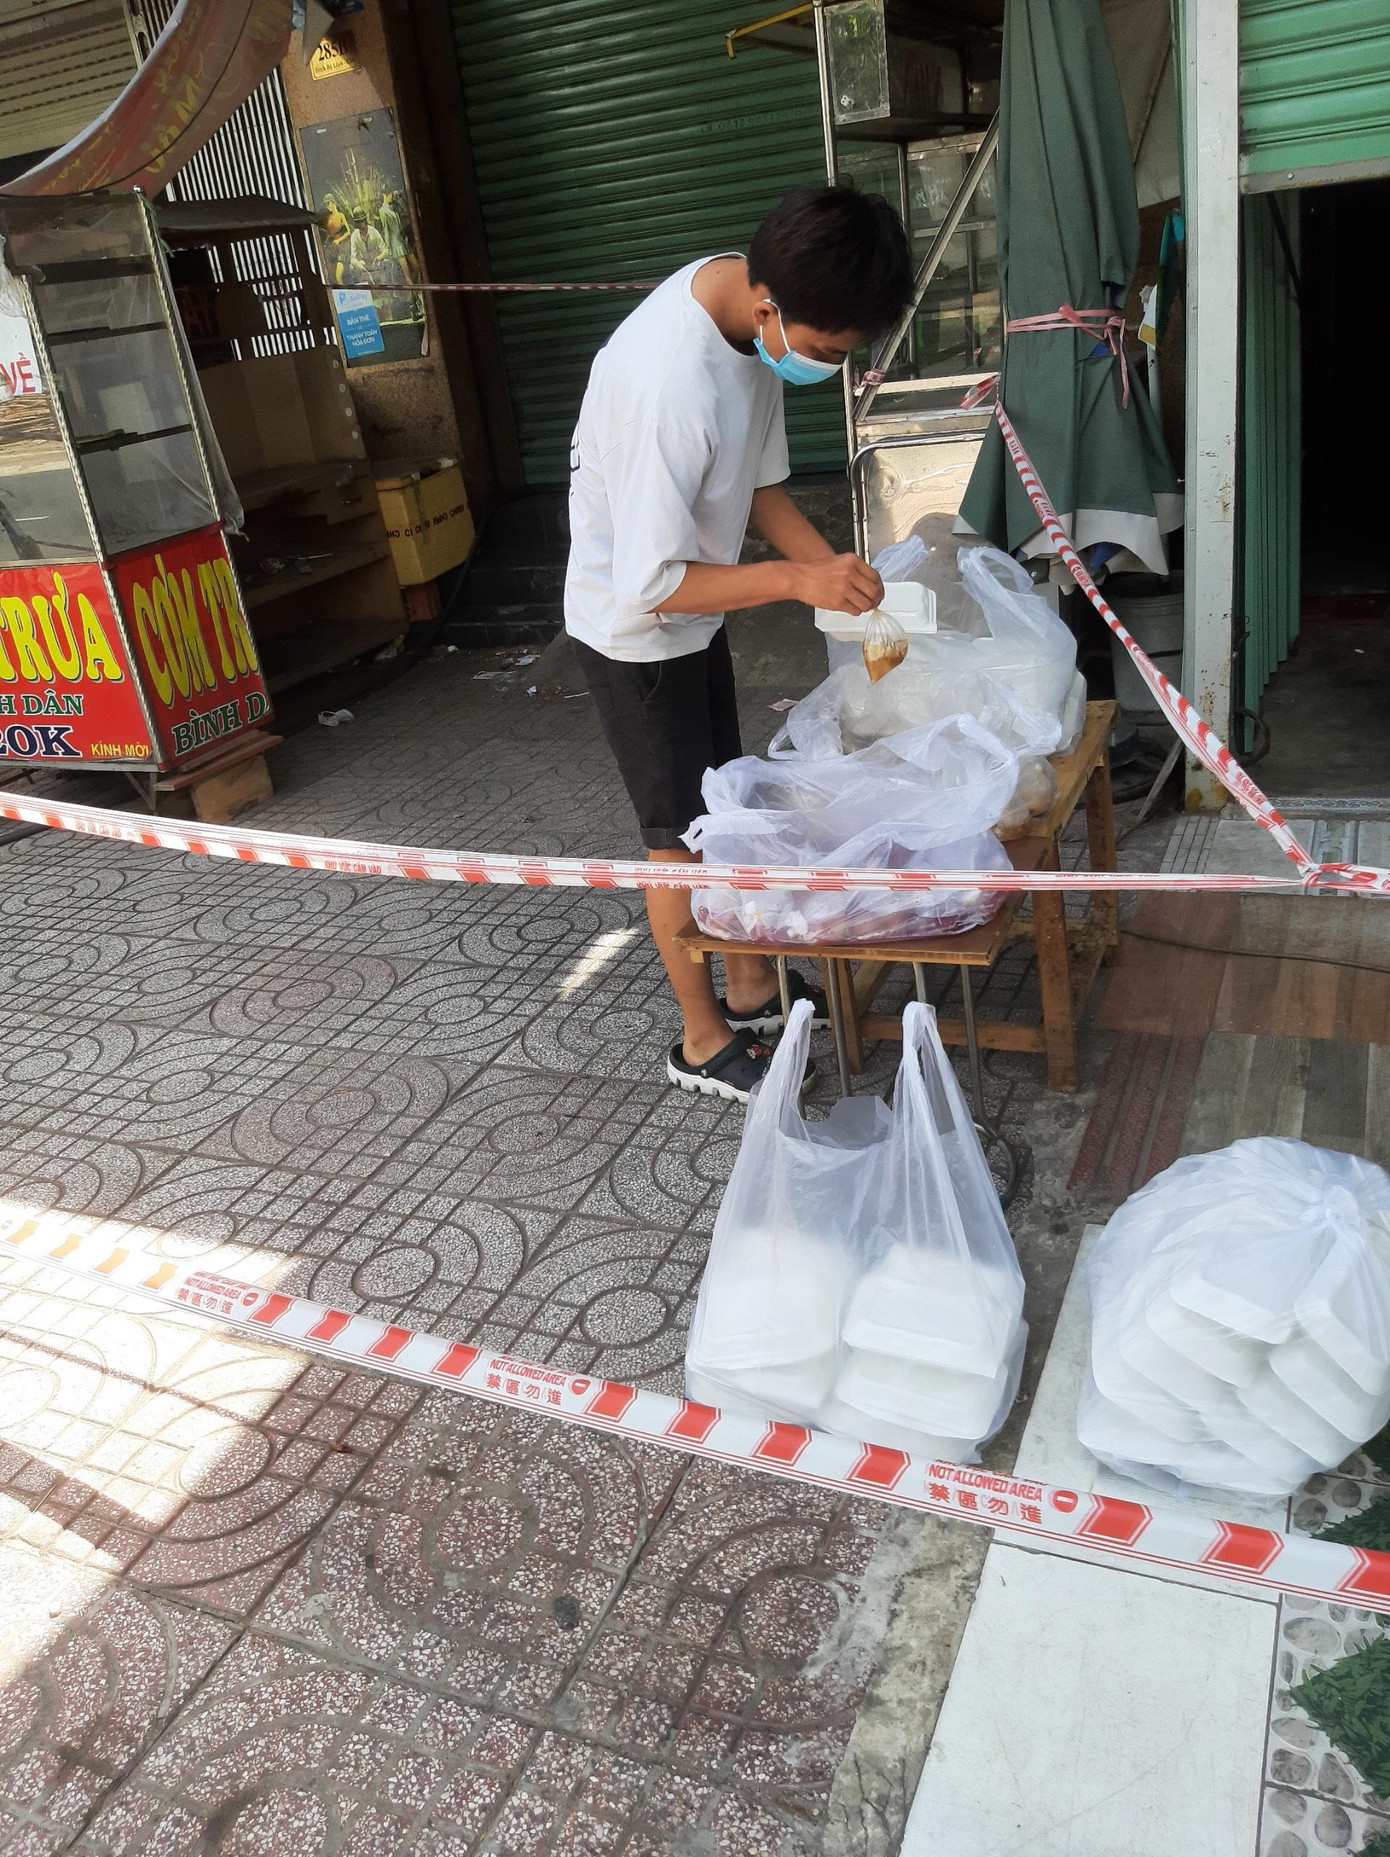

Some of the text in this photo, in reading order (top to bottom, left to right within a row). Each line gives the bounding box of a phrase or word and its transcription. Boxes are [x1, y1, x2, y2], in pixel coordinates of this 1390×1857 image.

[133, 553, 217, 709] CƠM
[23, 689, 84, 716] DÂN
[172, 699, 243, 757] BÌNH
[91, 741, 149, 757] KÍNH MỜI
[487, 1373, 562, 1405] 禁區勿進
[490, 1359, 510, 1371] NOT
[506, 1363, 544, 1381] ALLOWED
[542, 1372, 567, 1386] AREA
[928, 1464, 954, 1479] NOT
[953, 1470, 1010, 1494] ALLOWED
[1008, 1482, 1042, 1502] AREA
[929, 1482, 1042, 1524] 禁區勿進
